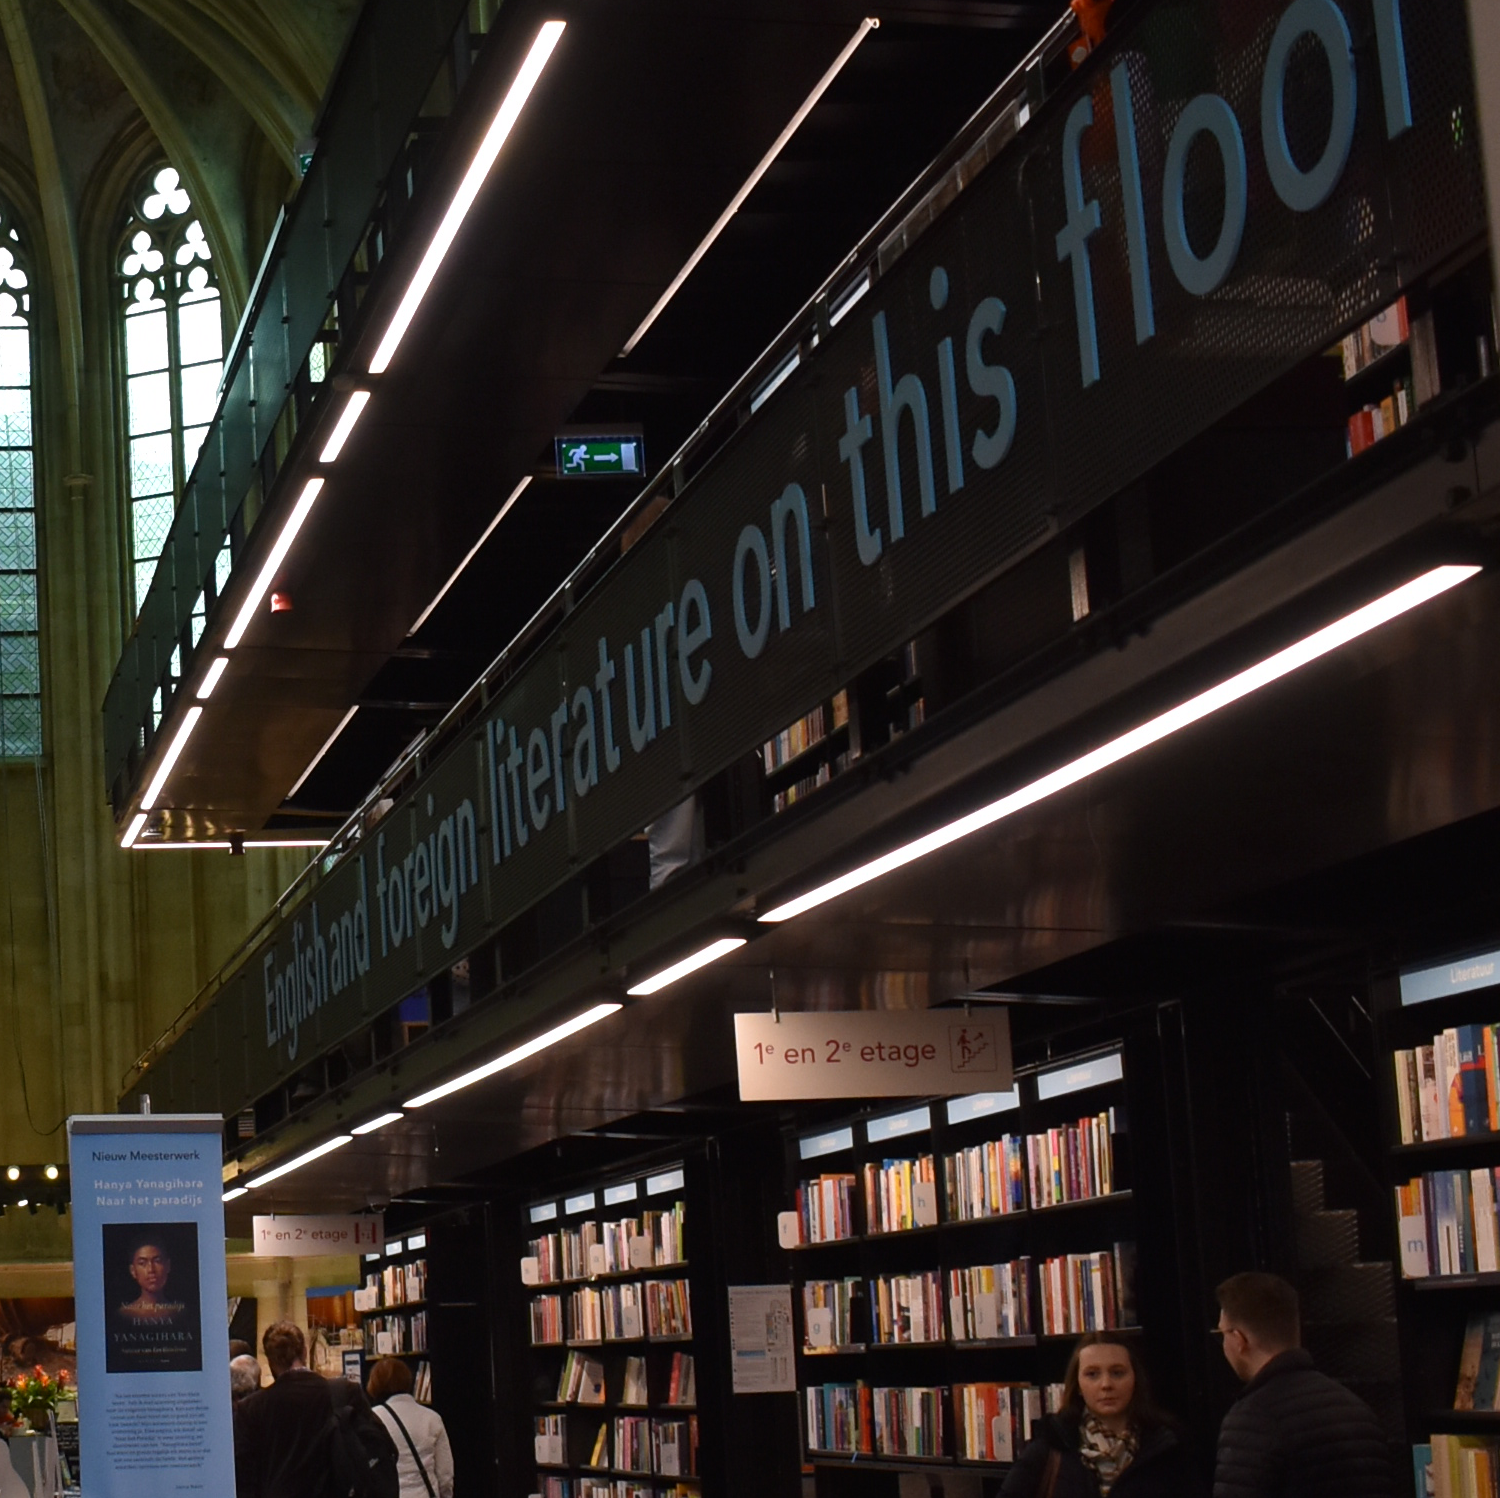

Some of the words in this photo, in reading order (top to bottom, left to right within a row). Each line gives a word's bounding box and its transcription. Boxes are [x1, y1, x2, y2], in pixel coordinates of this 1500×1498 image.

[263, 901, 328, 1061] English
[329, 856, 370, 996] and
[376, 794, 478, 949] foreign
[487, 578, 712, 865] literature
[732, 482, 815, 660] on
[839, 266, 1017, 567] this
[784, 1047, 816, 1064] en
[860, 1041, 936, 1068] etage
[91, 1151, 126, 1162] Nieuw
[130, 1149, 200, 1161] Meesterwerk
[94, 1179, 132, 1192] Hanya
[136, 1178, 204, 1191] Yanagihara
[96, 1196, 125, 1206] Naar
[129, 1195, 149, 1205] het
[153, 1194, 202, 1207] paradijs
[275, 1232, 291, 1240] en
[311, 1229, 348, 1242] etage
